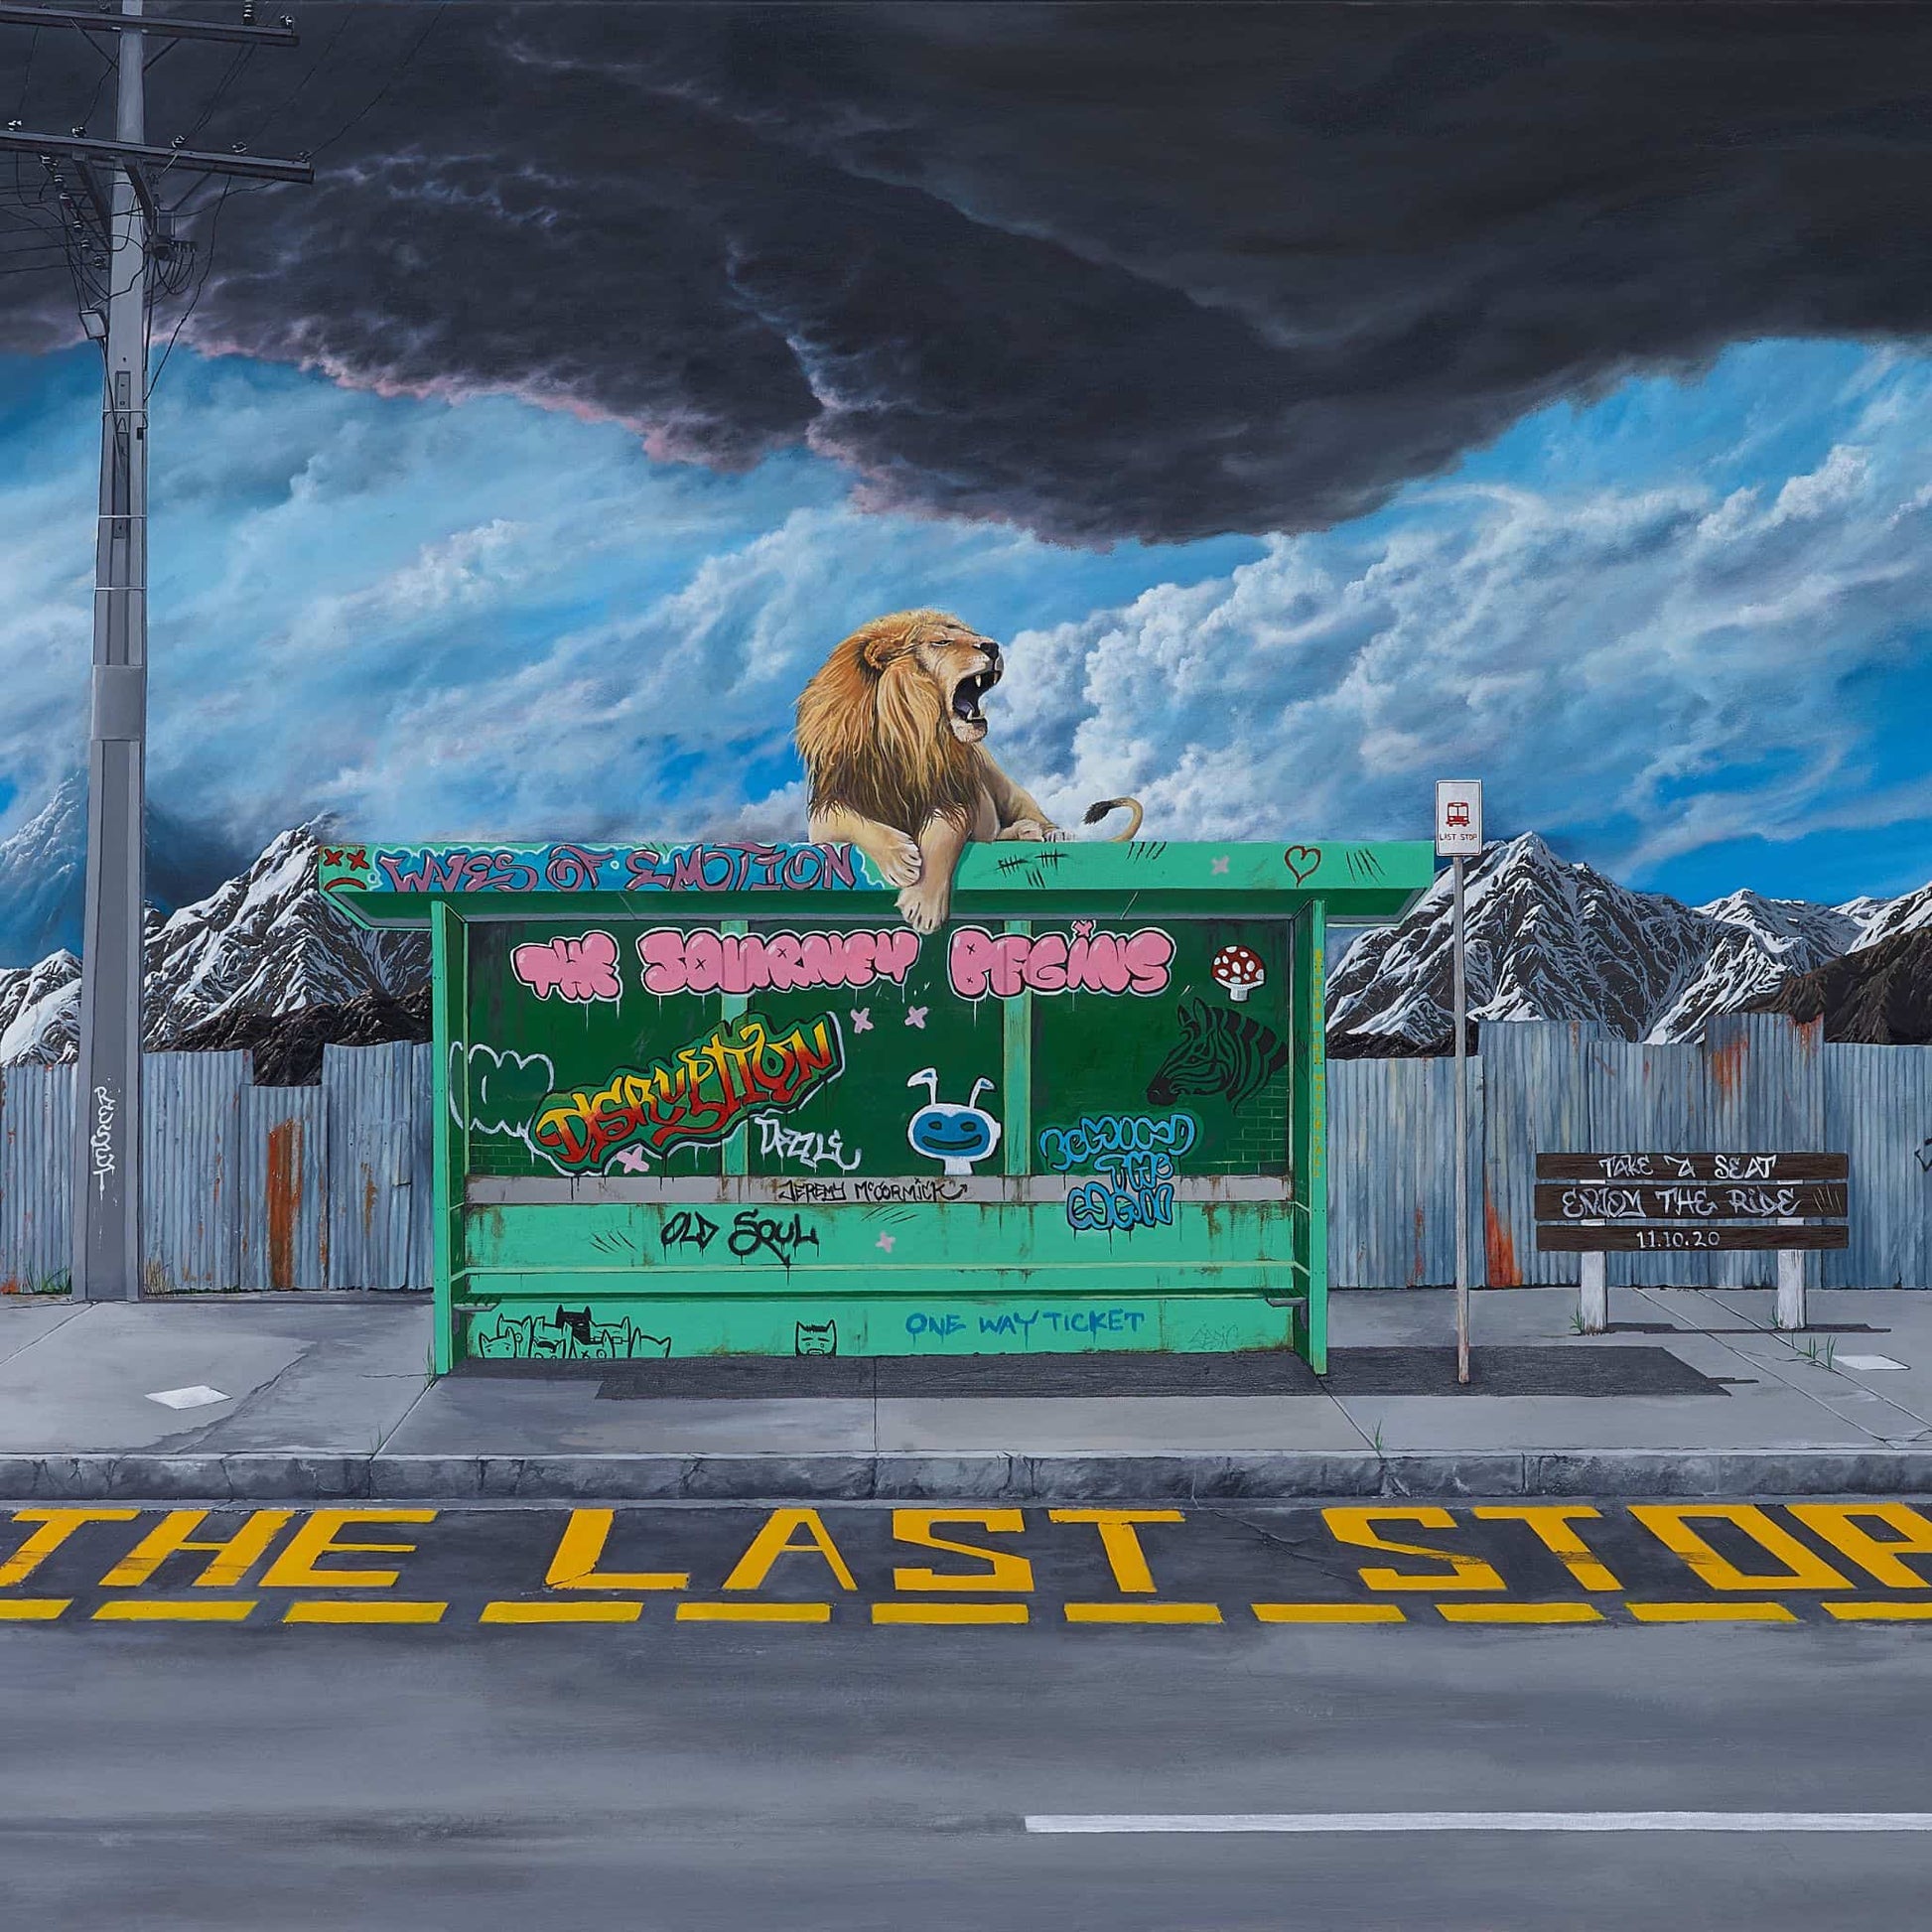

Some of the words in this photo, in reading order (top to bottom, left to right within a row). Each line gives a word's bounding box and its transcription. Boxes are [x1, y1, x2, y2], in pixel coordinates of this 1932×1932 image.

[377, 852, 539, 893] WAVES
[546, 844, 614, 892] OF
[624, 843, 856, 892] EMOTION
[510, 929, 621, 1001] THE
[636, 926, 921, 996] JOURNEY
[532, 1018, 837, 1168] DISRUPTION
[755, 1117, 862, 1170] DAZZLE
[1598, 1155, 1653, 1178] TAKE
[1664, 1155, 1696, 1178] A
[1715, 1155, 1776, 1179] SEAT
[778, 1178, 847, 1202] JEREMY
[1562, 1187, 1646, 1218] ENJOY
[1655, 1187, 1718, 1216] THE
[660, 1210, 720, 1251] OLD
[728, 1208, 820, 1265] SOUL
[1636, 1231, 1721, 1249] 11.10.20
[905, 1312, 966, 1336] ONE
[979, 1310, 1039, 1336] WAY
[1042, 1309, 1145, 1334] TICKET
[0, 1508, 439, 1587] THE
[544, 1508, 1185, 1592] LAST
[1321, 1502, 1932, 1590] STOP
